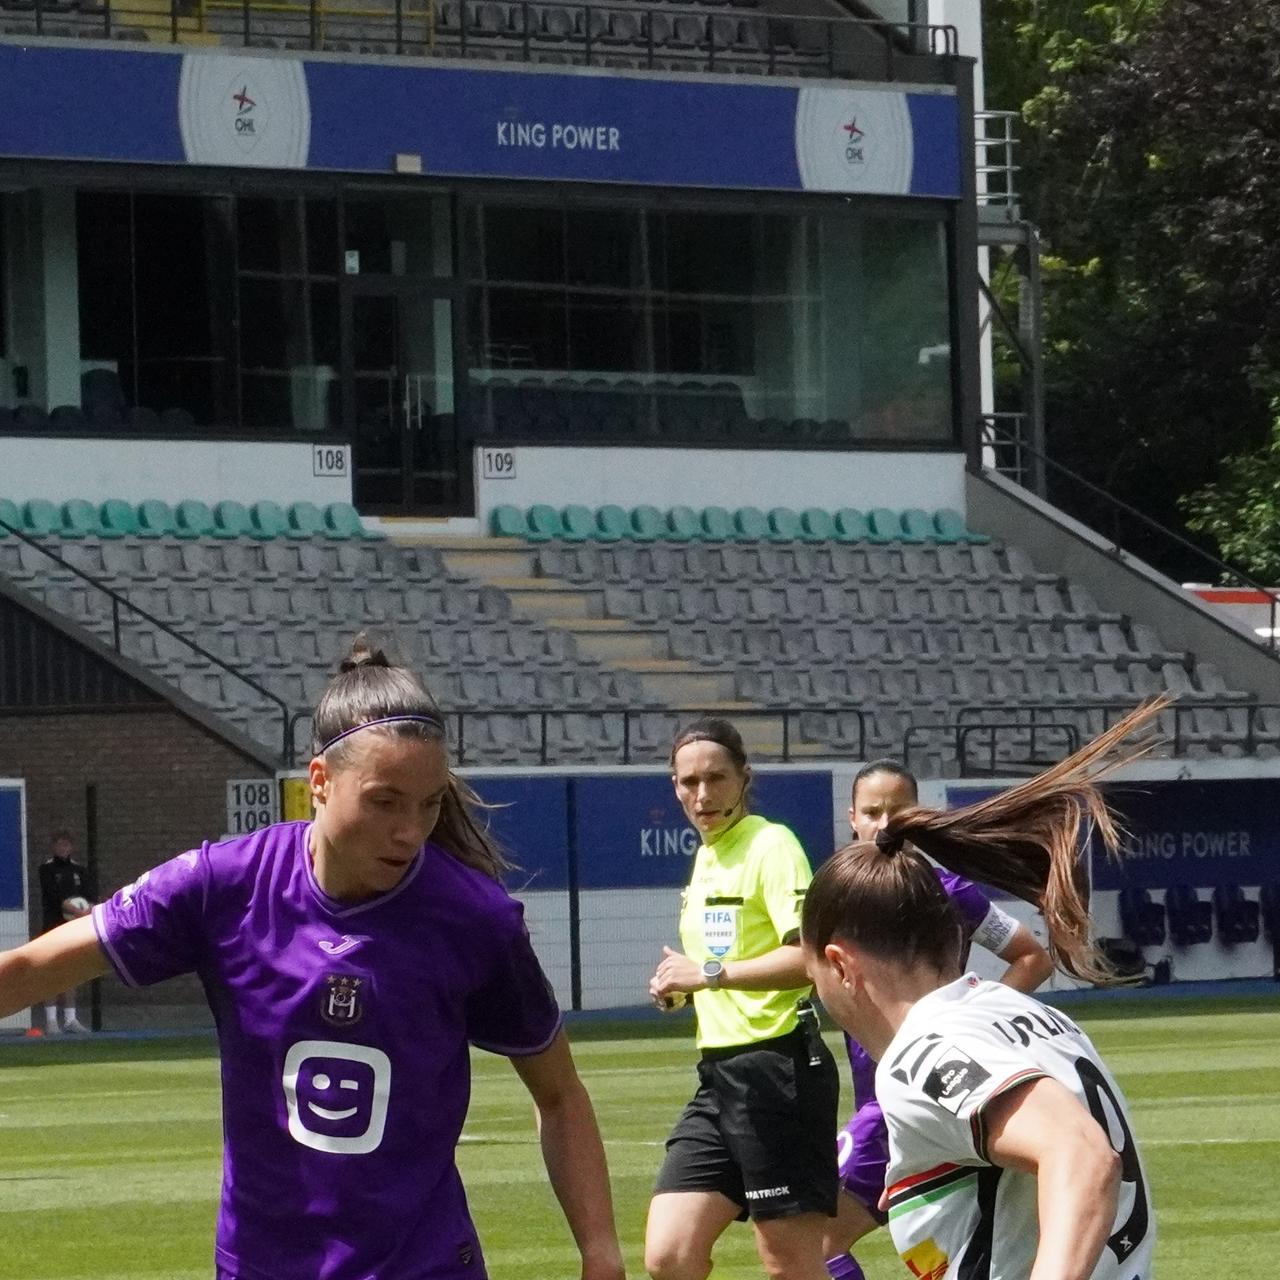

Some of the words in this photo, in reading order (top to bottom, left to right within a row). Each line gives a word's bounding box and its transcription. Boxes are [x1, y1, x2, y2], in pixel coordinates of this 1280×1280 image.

[497, 121, 547, 148] KING
[552, 124, 620, 151] POWER
[317, 450, 344, 470] 108
[486, 452, 513, 472] 109
[232, 784, 270, 805] 108
[233, 810, 271, 833] 109
[640, 828, 698, 856] KING
[1181, 832, 1251, 858] POWER
[704, 911, 732, 924] FIFA
[1073, 1056, 1149, 1265] 9
